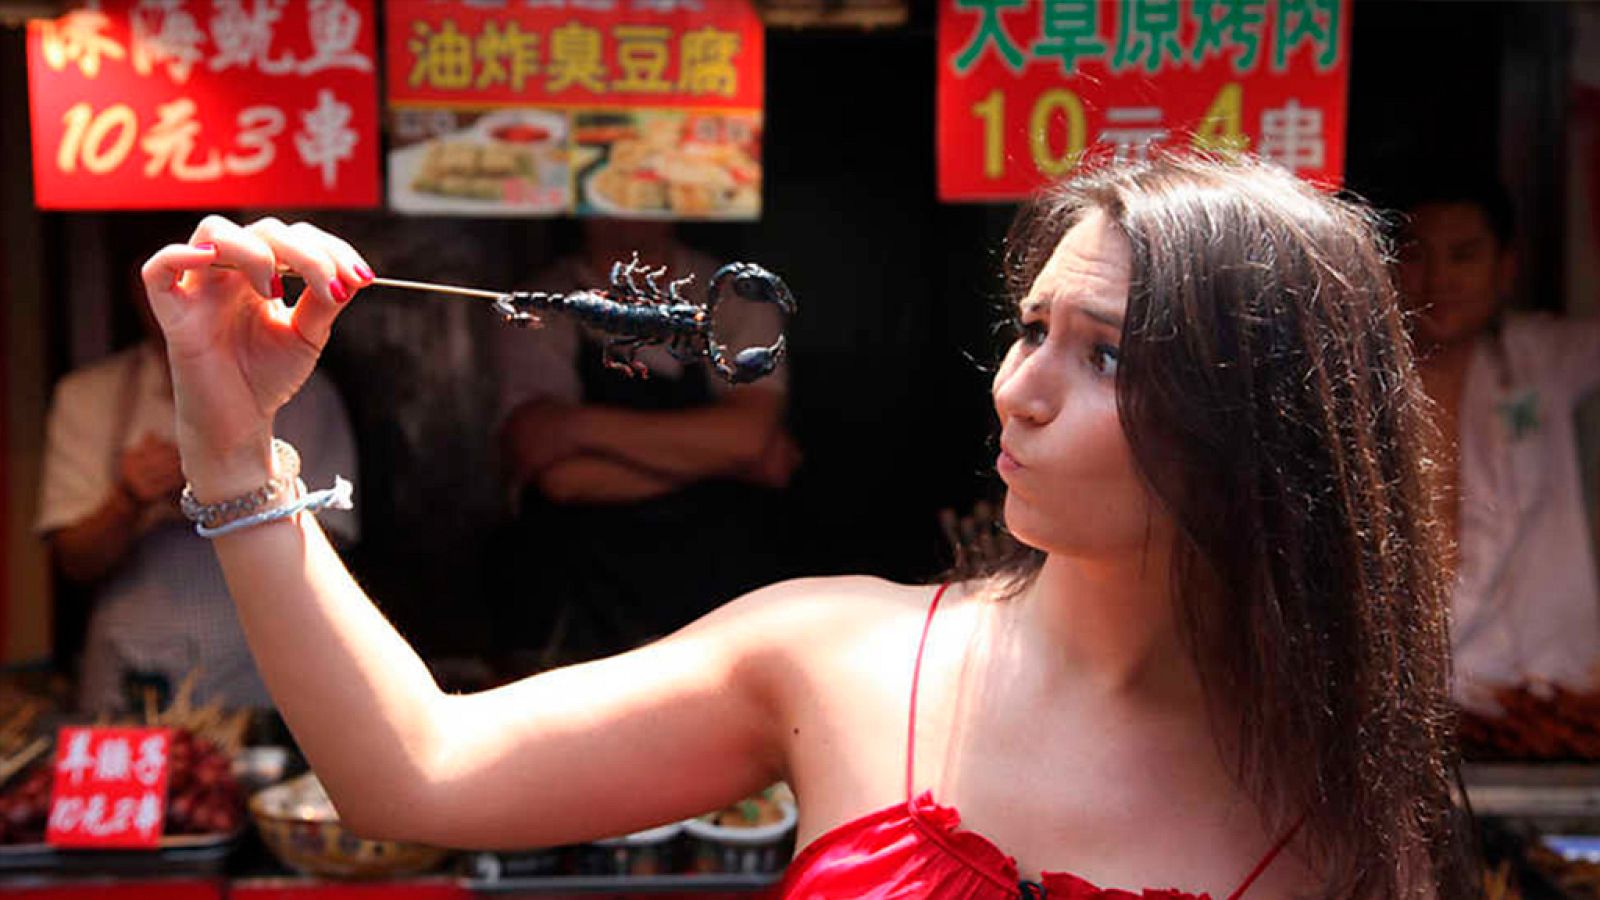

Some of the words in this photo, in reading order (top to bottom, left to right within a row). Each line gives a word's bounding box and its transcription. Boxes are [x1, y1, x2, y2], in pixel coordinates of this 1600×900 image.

[408, 19, 742, 97] 油炸臭豆腐
[951, 0, 1341, 75] 大草原烤肉
[56, 88, 360, 190] 10元3串
[970, 82, 1325, 178] 10元4串
